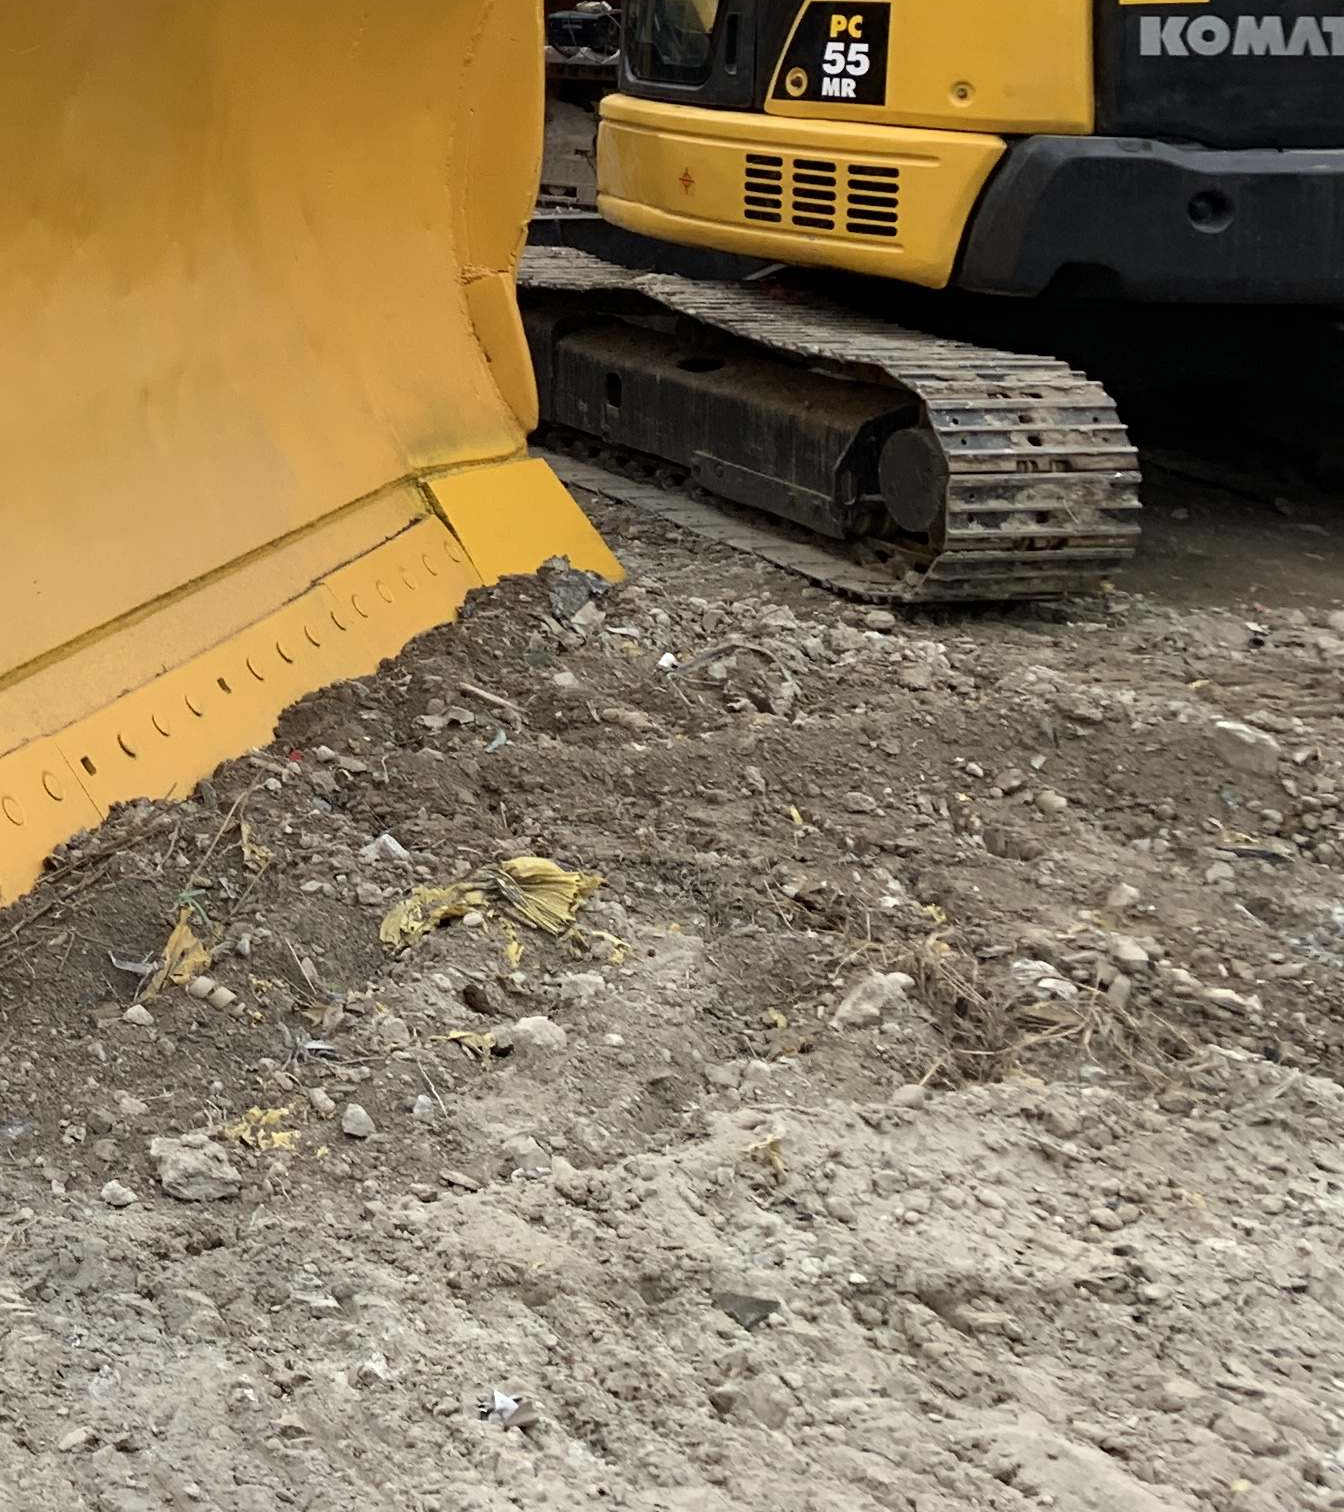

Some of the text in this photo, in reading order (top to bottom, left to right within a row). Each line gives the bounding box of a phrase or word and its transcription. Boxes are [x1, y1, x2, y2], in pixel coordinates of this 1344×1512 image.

[830, 14, 864, 39] PC
[822, 41, 871, 76] 55
[821, 76, 857, 98] MR
